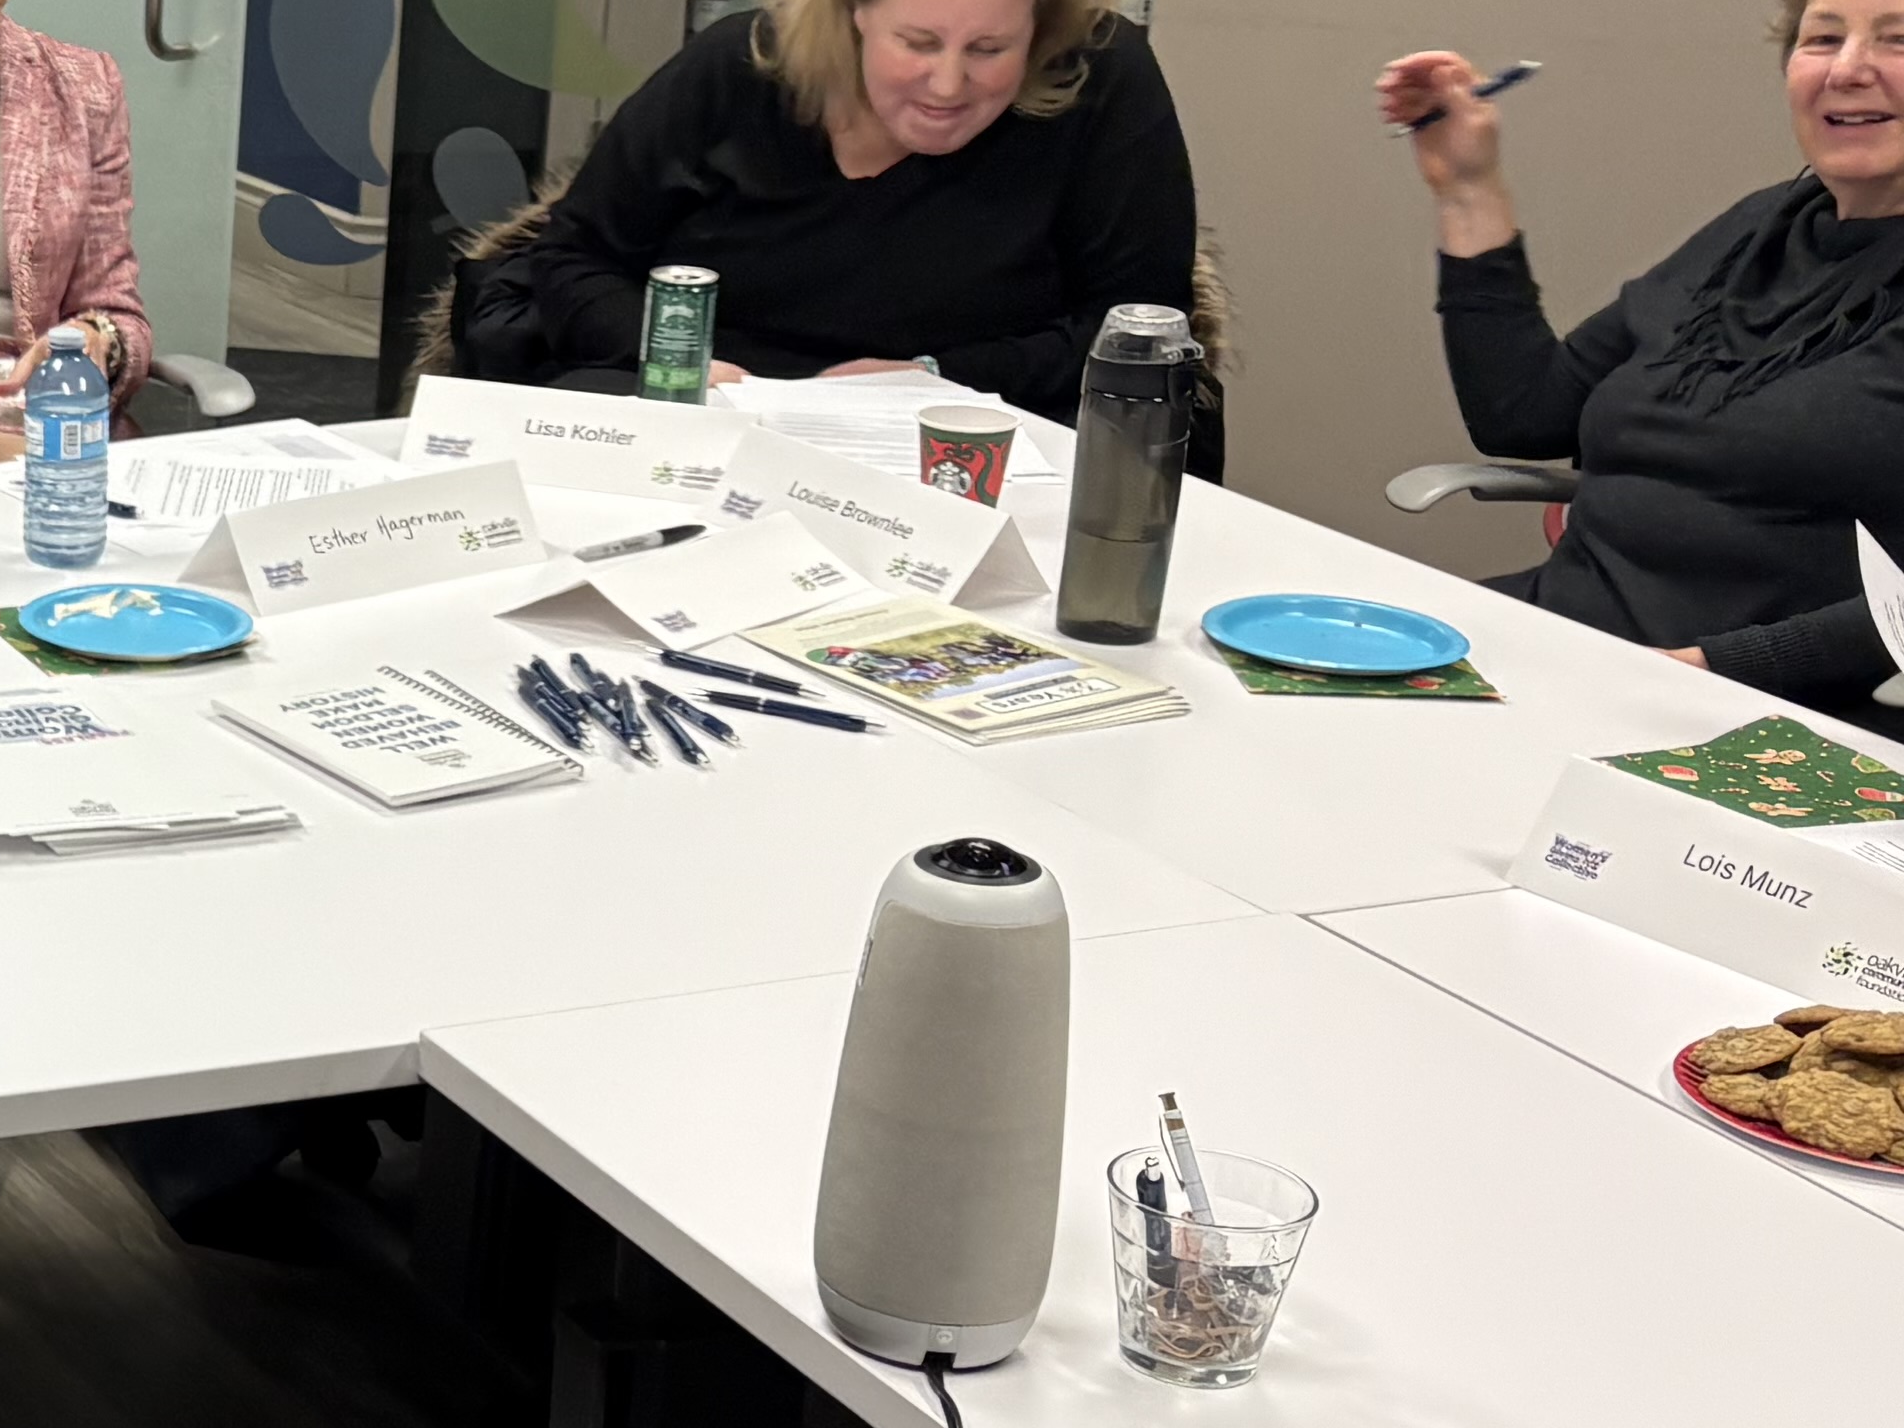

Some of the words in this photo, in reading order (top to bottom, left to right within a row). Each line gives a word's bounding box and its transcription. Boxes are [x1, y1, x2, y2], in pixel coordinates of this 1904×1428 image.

[524, 419, 566, 438] Lisa
[309, 528, 368, 554] Esther
[376, 509, 465, 540] Hagerman
[279, 687, 386, 712] HISTORY
[309, 698, 385, 718] MAKE
[310, 704, 418, 730] SELDOM
[331, 714, 436, 738] WOMEN
[341, 720, 462, 749] BEHAVED
[379, 735, 458, 754] WELL
[1683, 843, 1736, 881] Lois
[1740, 864, 1813, 909] Munz
